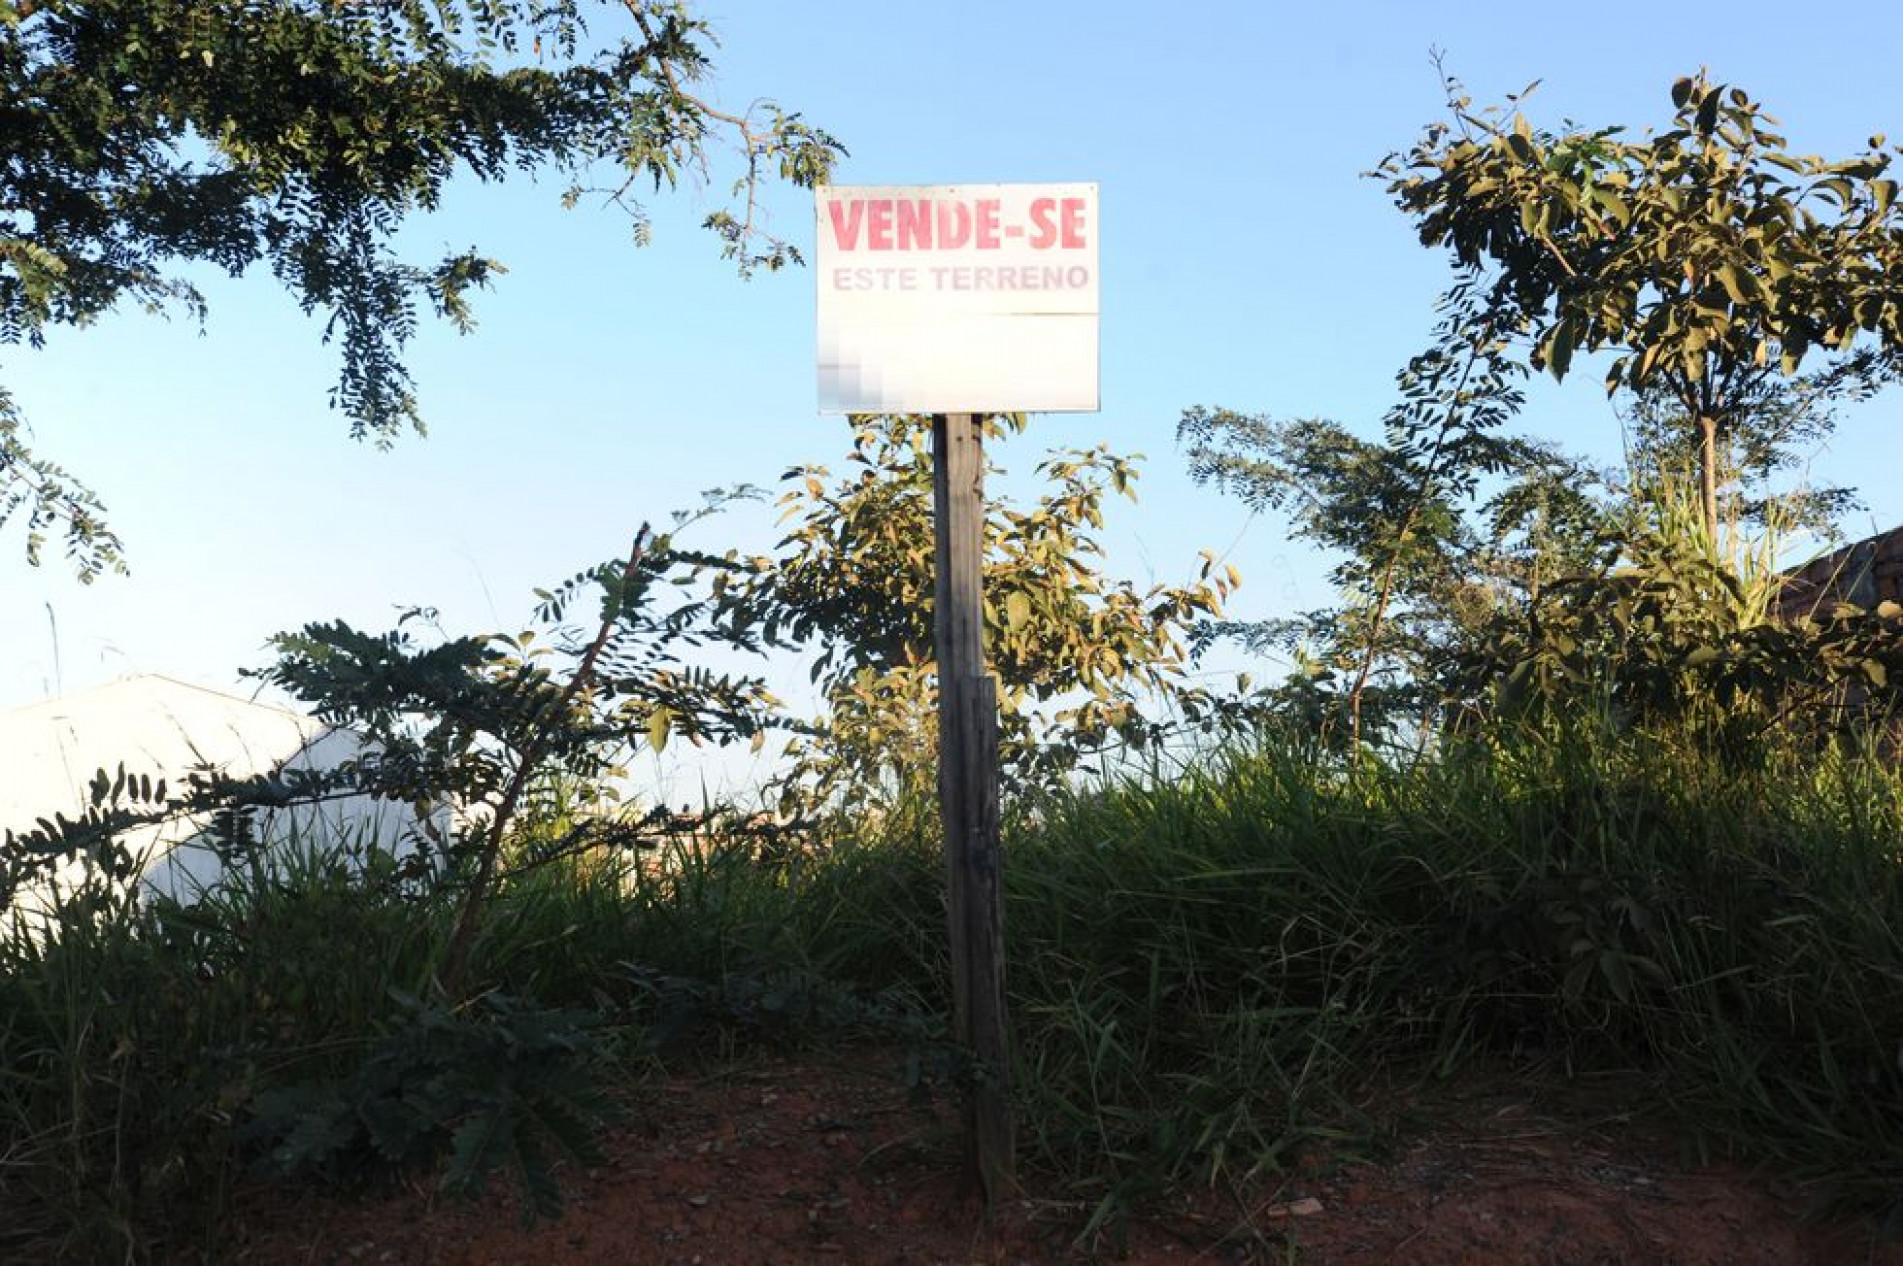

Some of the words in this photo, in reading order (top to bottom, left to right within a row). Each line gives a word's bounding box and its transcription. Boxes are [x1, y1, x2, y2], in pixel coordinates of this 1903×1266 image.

[828, 197, 1086, 251] VENDE-SE
[833, 267, 917, 290] ESTE
[929, 266, 1089, 290] TERRENO
